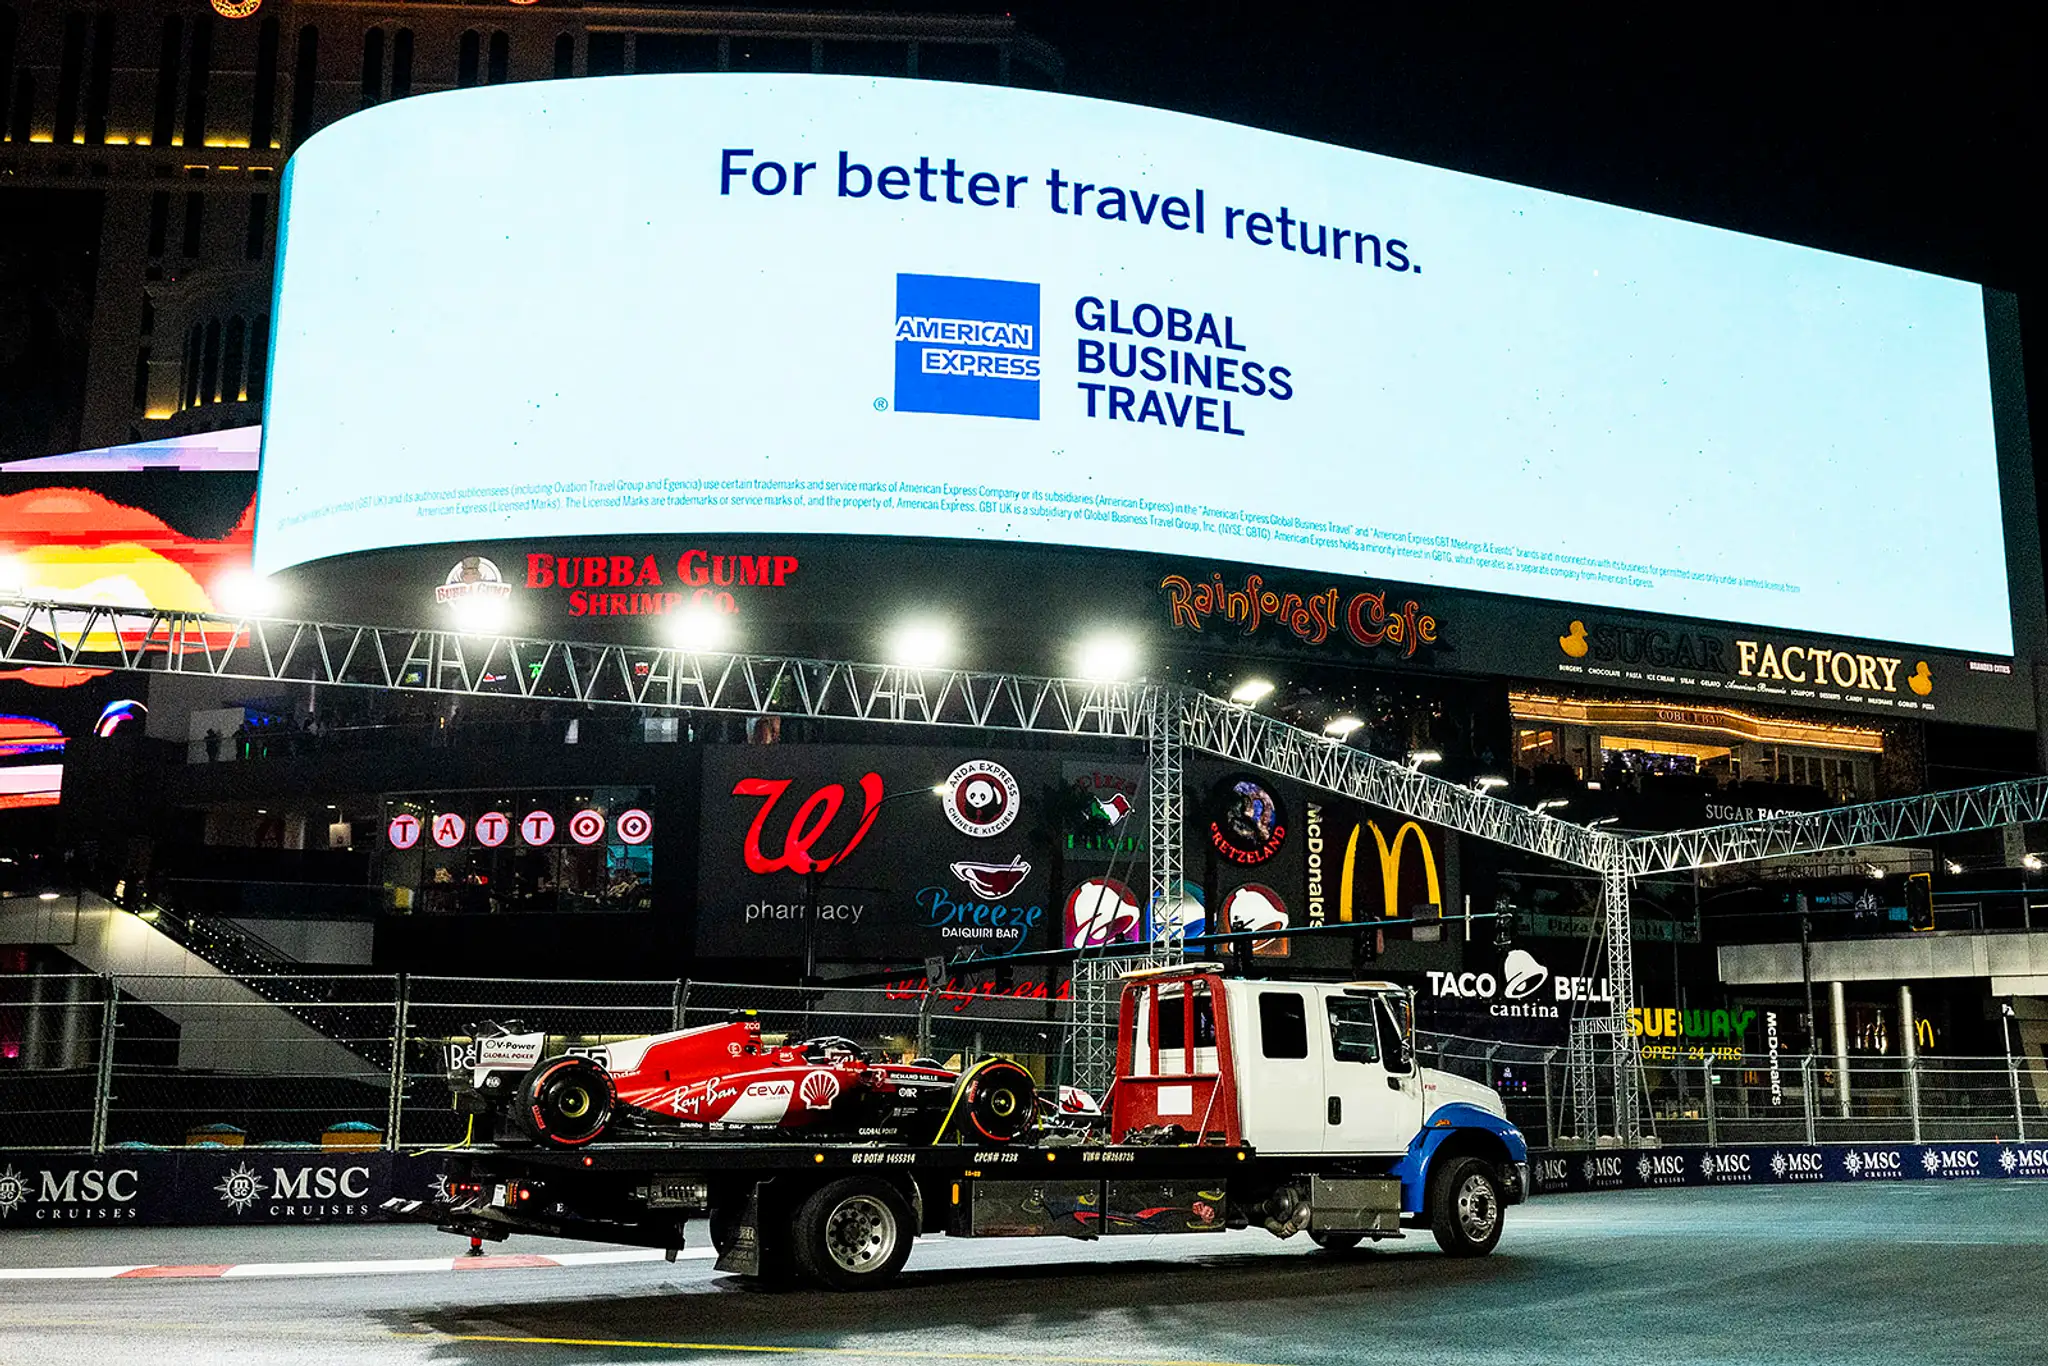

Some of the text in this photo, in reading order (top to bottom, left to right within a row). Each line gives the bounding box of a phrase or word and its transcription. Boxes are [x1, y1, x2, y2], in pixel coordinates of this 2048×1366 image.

[720, 149, 1423, 273] For better travel returns.
[896, 319, 1029, 346] AMERICAN
[1075, 296, 1246, 352] GLOBAL
[924, 351, 1041, 377] EXPRESS
[1077, 340, 1294, 400] BUSINESS
[1078, 382, 1245, 436] TRAVEL
[589, 480, 614, 491] Travel
[616, 479, 644, 492] Group
[645, 479, 661, 490] and
[663, 479, 702, 491] Egencia)
[703, 480, 718, 489] use
[720, 479, 752, 489] certain
[754, 479, 805, 490] trademarks
[806, 480, 824, 490] and
[825, 480, 856, 491] service
[858, 480, 886, 492] marks
[899, 482, 941, 494] American
[943, 484, 977, 498] Express
[978, 486, 1019, 501] Company
[1032, 490, 1042, 501] its
[1044, 490, 1092, 504] subsidiaries
[1095, 494, 1137, 510] (American
[1139, 498, 1174, 514] Express)
[566, 497, 579, 508] The
[582, 495, 620, 507] Licensed
[622, 495, 648, 506] Marks
[650, 496, 664, 505] are
[666, 494, 717, 505] trademarks
[731, 494, 762, 505] service
[764, 494, 792, 505] marks
[807, 495, 824, 506] and
[826, 495, 840, 506] the
[842, 496, 880, 509] property
[896, 497, 938, 510] American
[979, 501, 996, 513] GBT
[1029, 504, 1072, 519] subsidiary
[1084, 507, 1109, 520] Global
[1111, 510, 1147, 524] Business
[1150, 514, 1172, 527] Travel
[525, 550, 799, 589] BUBBA GUMP
[569, 590, 681, 617] SHRIMP
[1161, 573, 1438, 658] Rainforest Cafe
[1594, 623, 1901, 692] SUGAR FACTORY
[979, 763, 1018, 797] EXPRESS
[948, 807, 1015, 835] CHINESE KITCHEN
[1705, 804, 1754, 821] SUGAR
[389, 809, 651, 848] TATTOO
[1307, 802, 1324, 928] McDonald's
[915, 886, 1042, 956] Breeze
[942, 927, 1019, 939] DAIQUIRI BAR
[1426, 971, 1614, 1001] TACO BELL
[1490, 1003, 1559, 1018] cantina
[496, 1042, 536, 1050] V-Power
[1688, 1046, 1704, 1060] 24
[1766, 1011, 1782, 1106] McDonald's
[852, 1153, 863, 1163] US
[1545, 1159, 1567, 1180] MSC
[1596, 1157, 1622, 1176] MSC
[1653, 1155, 1684, 1174] MSC
[1716, 1154, 1750, 1172] MSC
[1788, 1153, 1822, 1171] MSC
[1863, 1150, 1901, 1169] MSC
[1941, 1149, 1979, 1168] MSC
[38, 1170, 139, 1202] MSC
[271, 1167, 370, 1200] MSC
[36, 1208, 137, 1219] CRUISES
[270, 1205, 368, 1216] CRUISES
